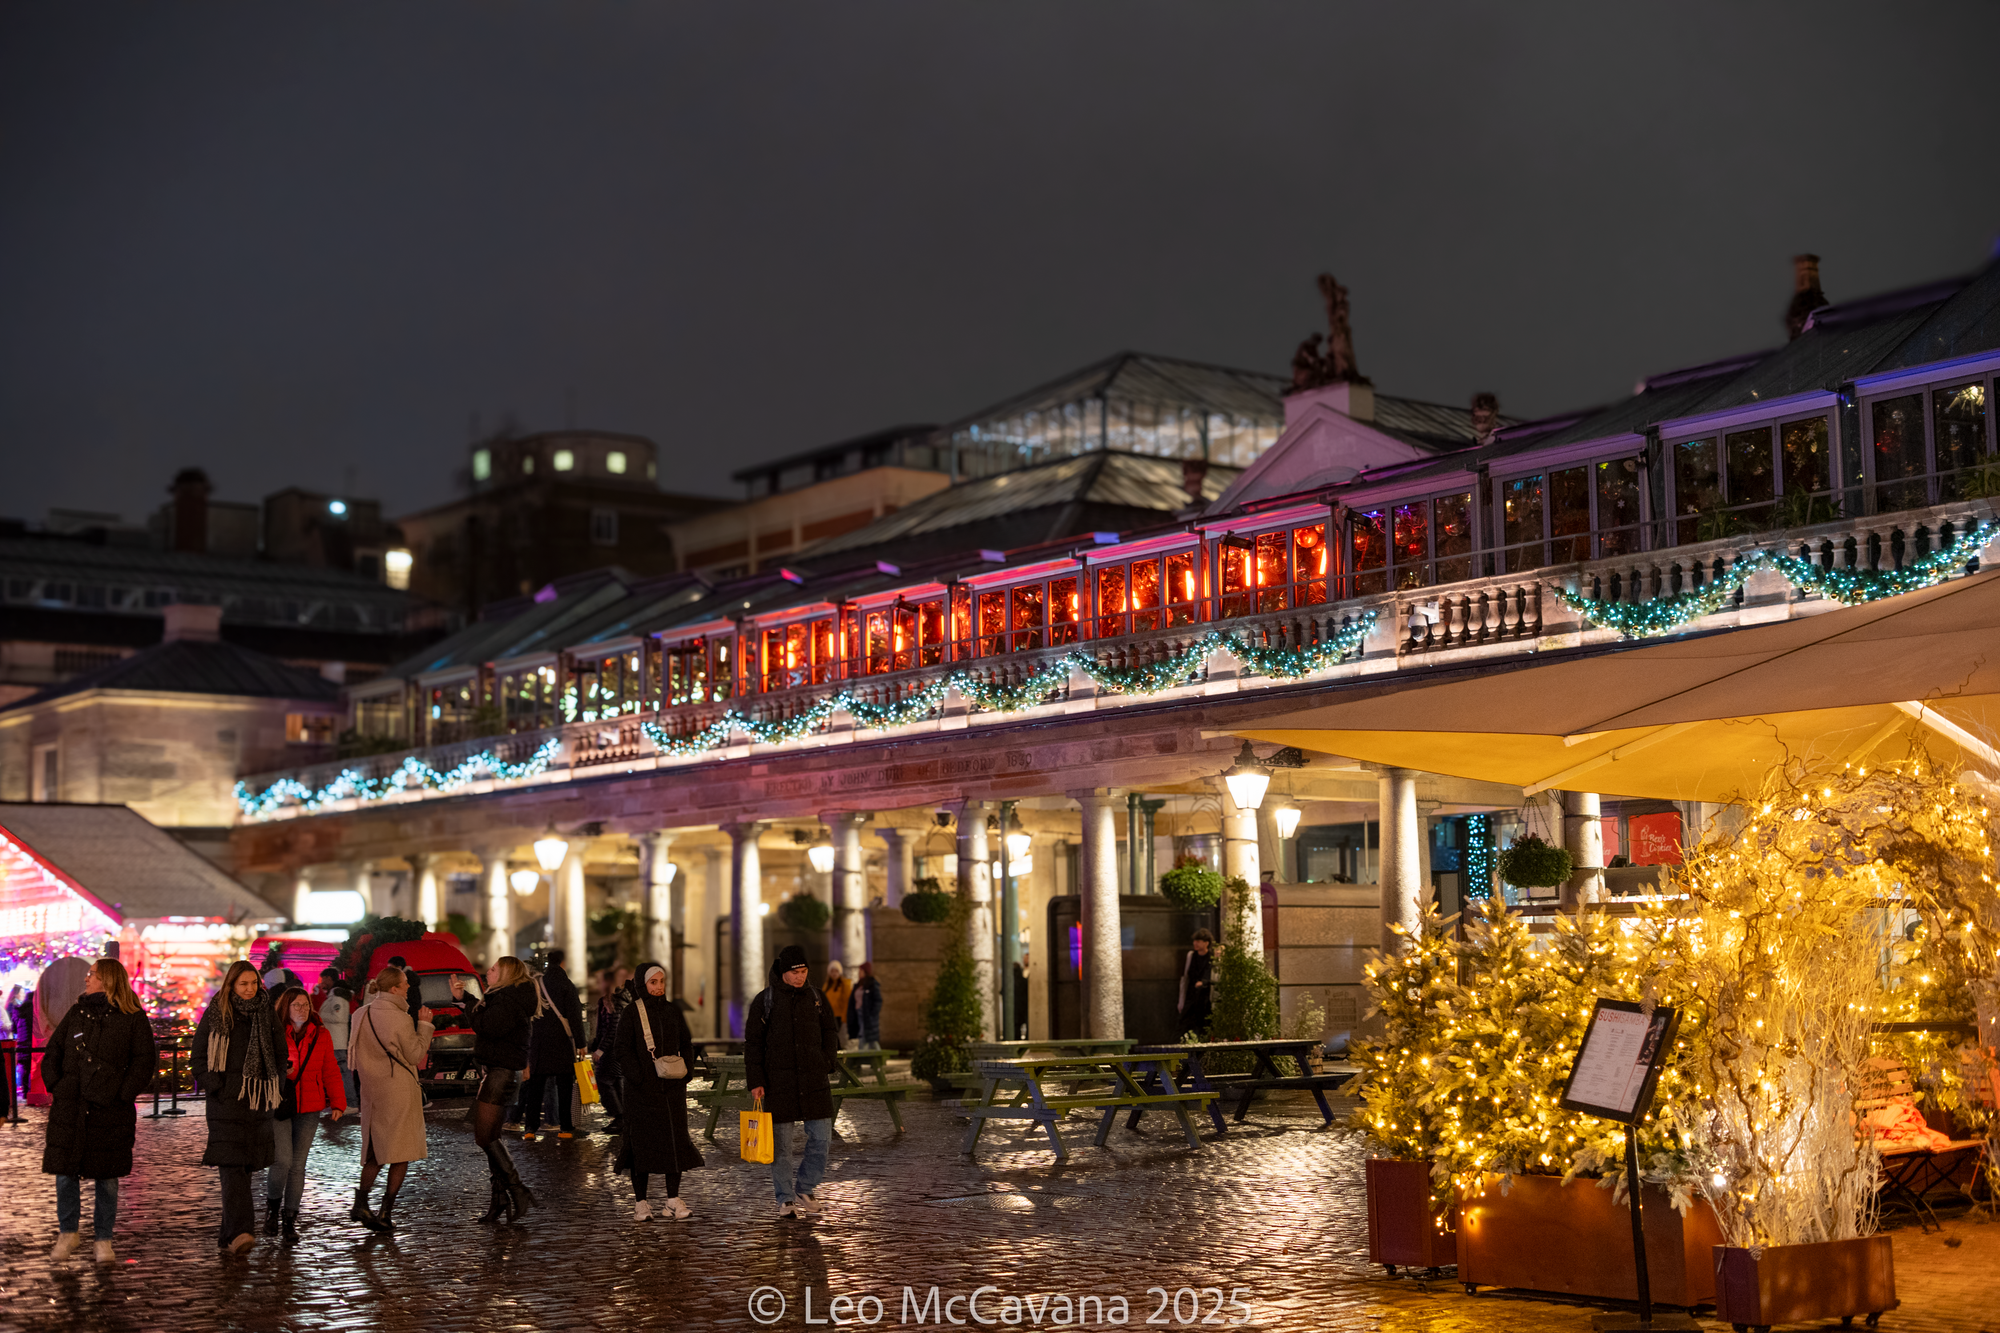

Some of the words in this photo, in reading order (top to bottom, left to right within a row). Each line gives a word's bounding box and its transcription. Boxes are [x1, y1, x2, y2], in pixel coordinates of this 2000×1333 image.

[840, 771, 869, 785] JOHN
[942, 757, 996, 775] BEDFORD
[1006, 753, 1032, 769] 1830
